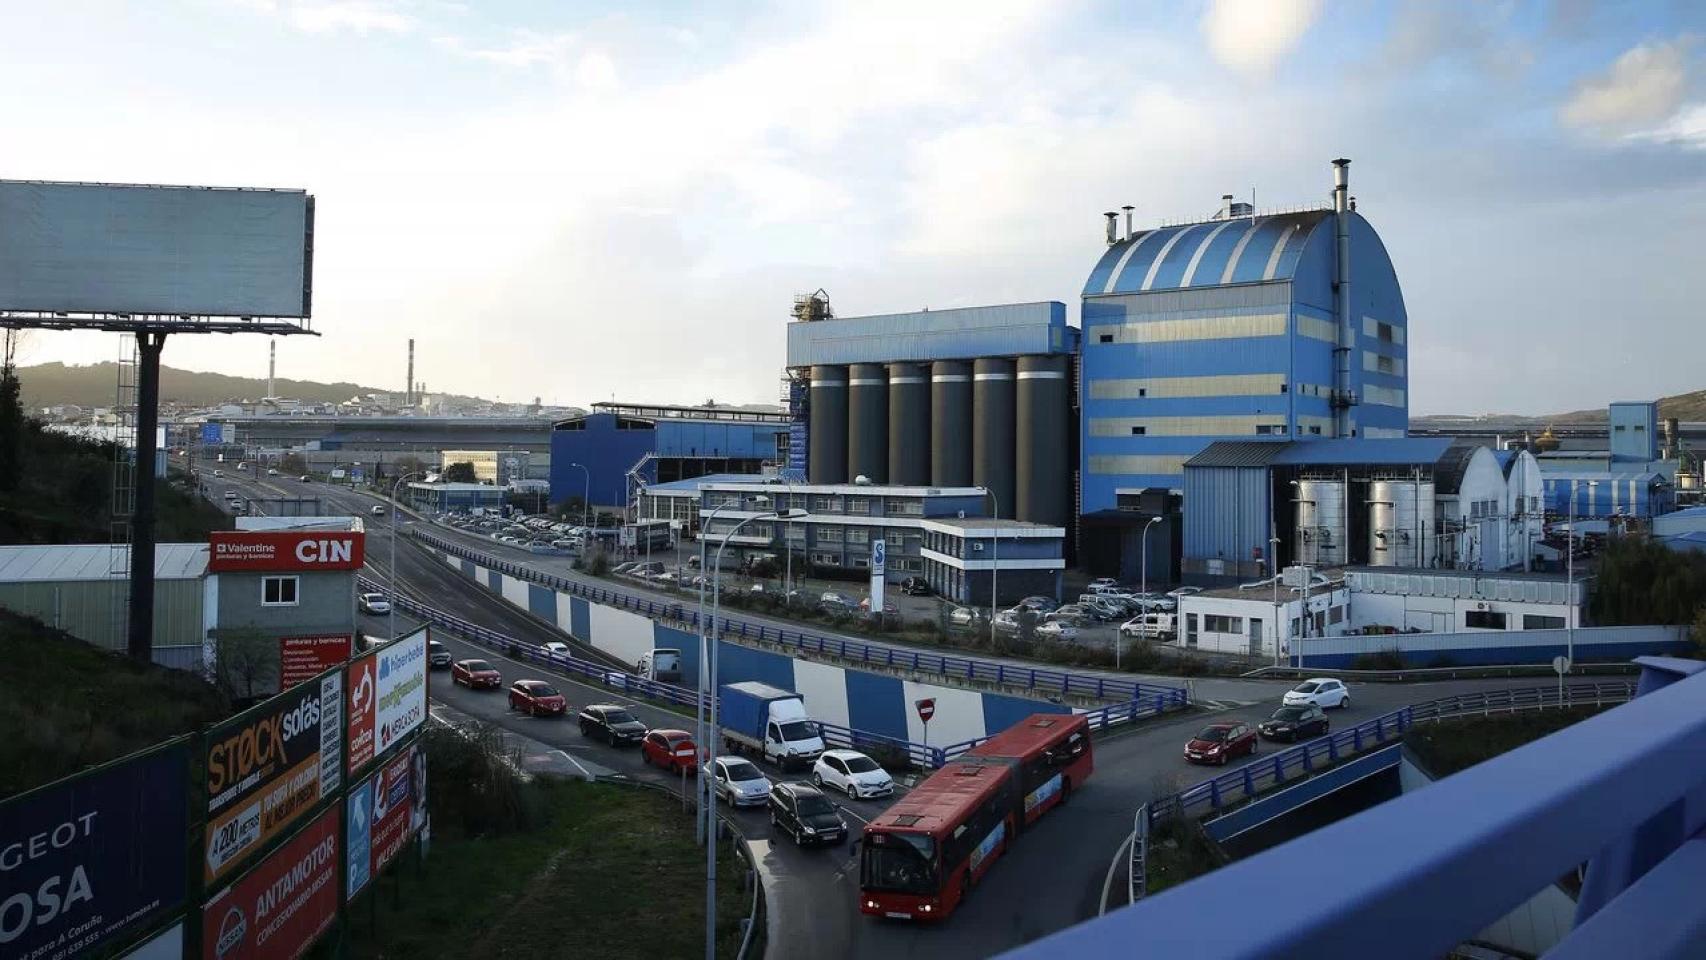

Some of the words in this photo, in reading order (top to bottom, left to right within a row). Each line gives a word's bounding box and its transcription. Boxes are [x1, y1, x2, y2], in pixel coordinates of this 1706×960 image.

[228, 543, 276, 553] Valentine
[296, 540, 352, 562] CIN
[283, 693, 320, 742] sofás
[220, 816, 239, 850] 200
[255, 834, 335, 925] ANTAMOTOR
[68, 915, 102, 939] Coruña
